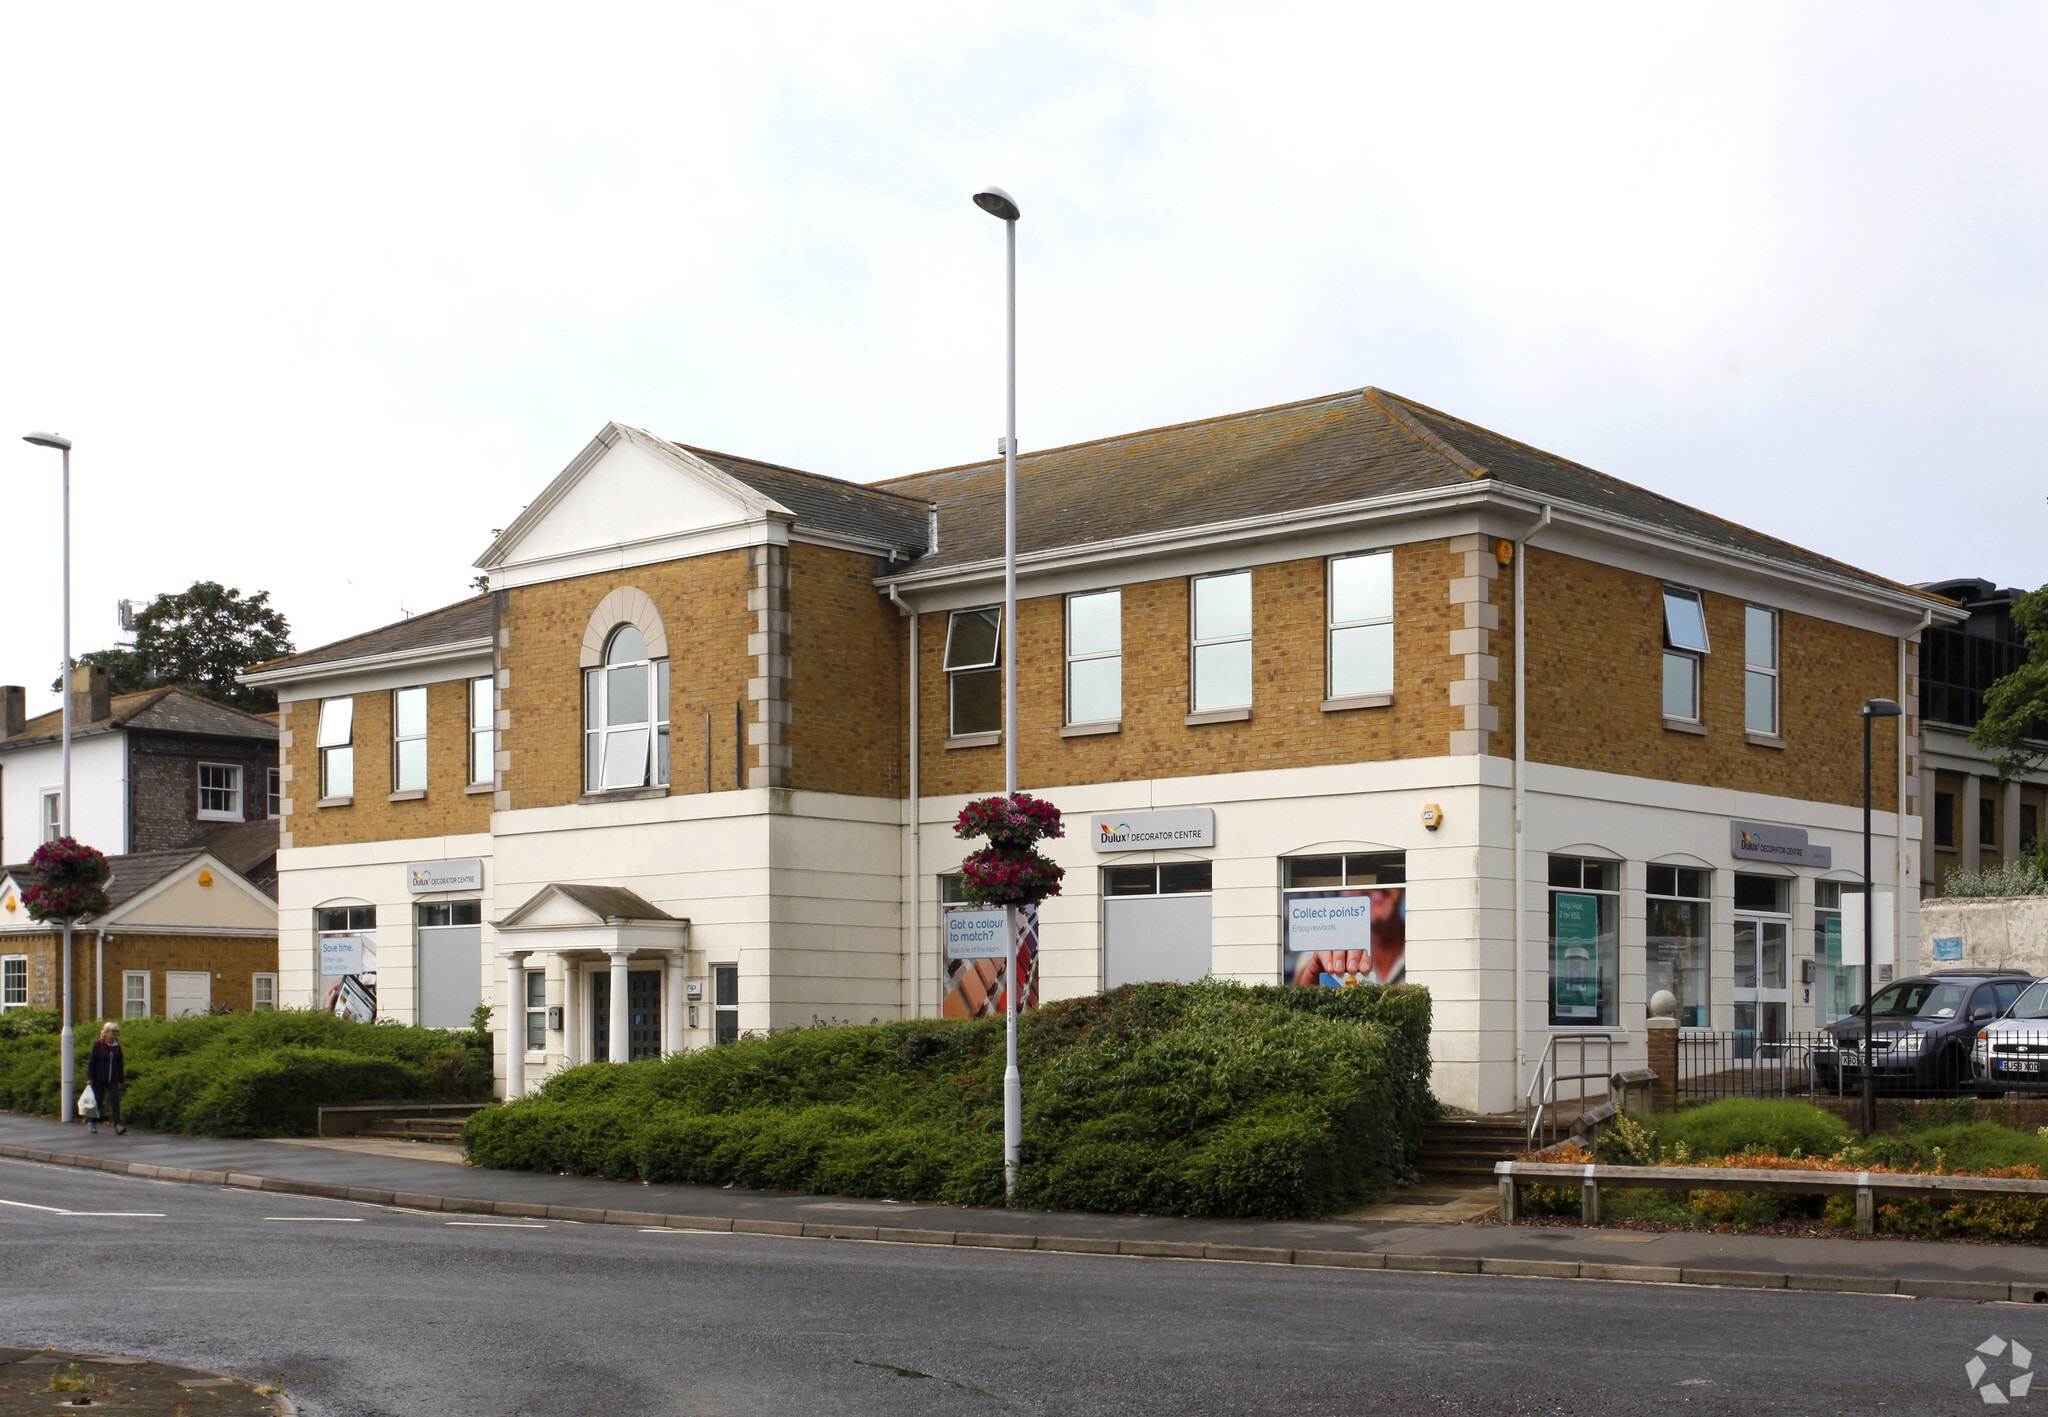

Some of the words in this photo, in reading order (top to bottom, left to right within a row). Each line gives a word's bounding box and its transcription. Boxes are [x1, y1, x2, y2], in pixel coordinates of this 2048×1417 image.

[1101, 833, 1127, 844] Dulux
[1131, 831, 1173, 842] DECORATOR
[1174, 829, 1202, 839] CENTRE
[1741, 840, 1759, 851] Dulux
[1760, 844, 1786, 855] DECORATOR
[1786, 847, 1803, 857] CENTRE
[413, 878, 429, 887] Dulux
[431, 877, 457, 886] DECORATOR
[457, 875, 475, 884] CENTRE
[1559, 901, 1572, 911] Vinyl
[1292, 907, 1327, 919] Collect
[1329, 905, 1366, 920] points?
[950, 919, 966, 930] Got
[967, 921, 974, 929] a
[975, 918, 1004, 929] colour
[1292, 924, 1310, 933] Enjoy
[949, 932, 959, 942] to
[960, 930, 994, 942] match?
[323, 943, 338, 953] Save
[338, 943, 354, 952] time.
[950, 946, 960, 954] Ask
